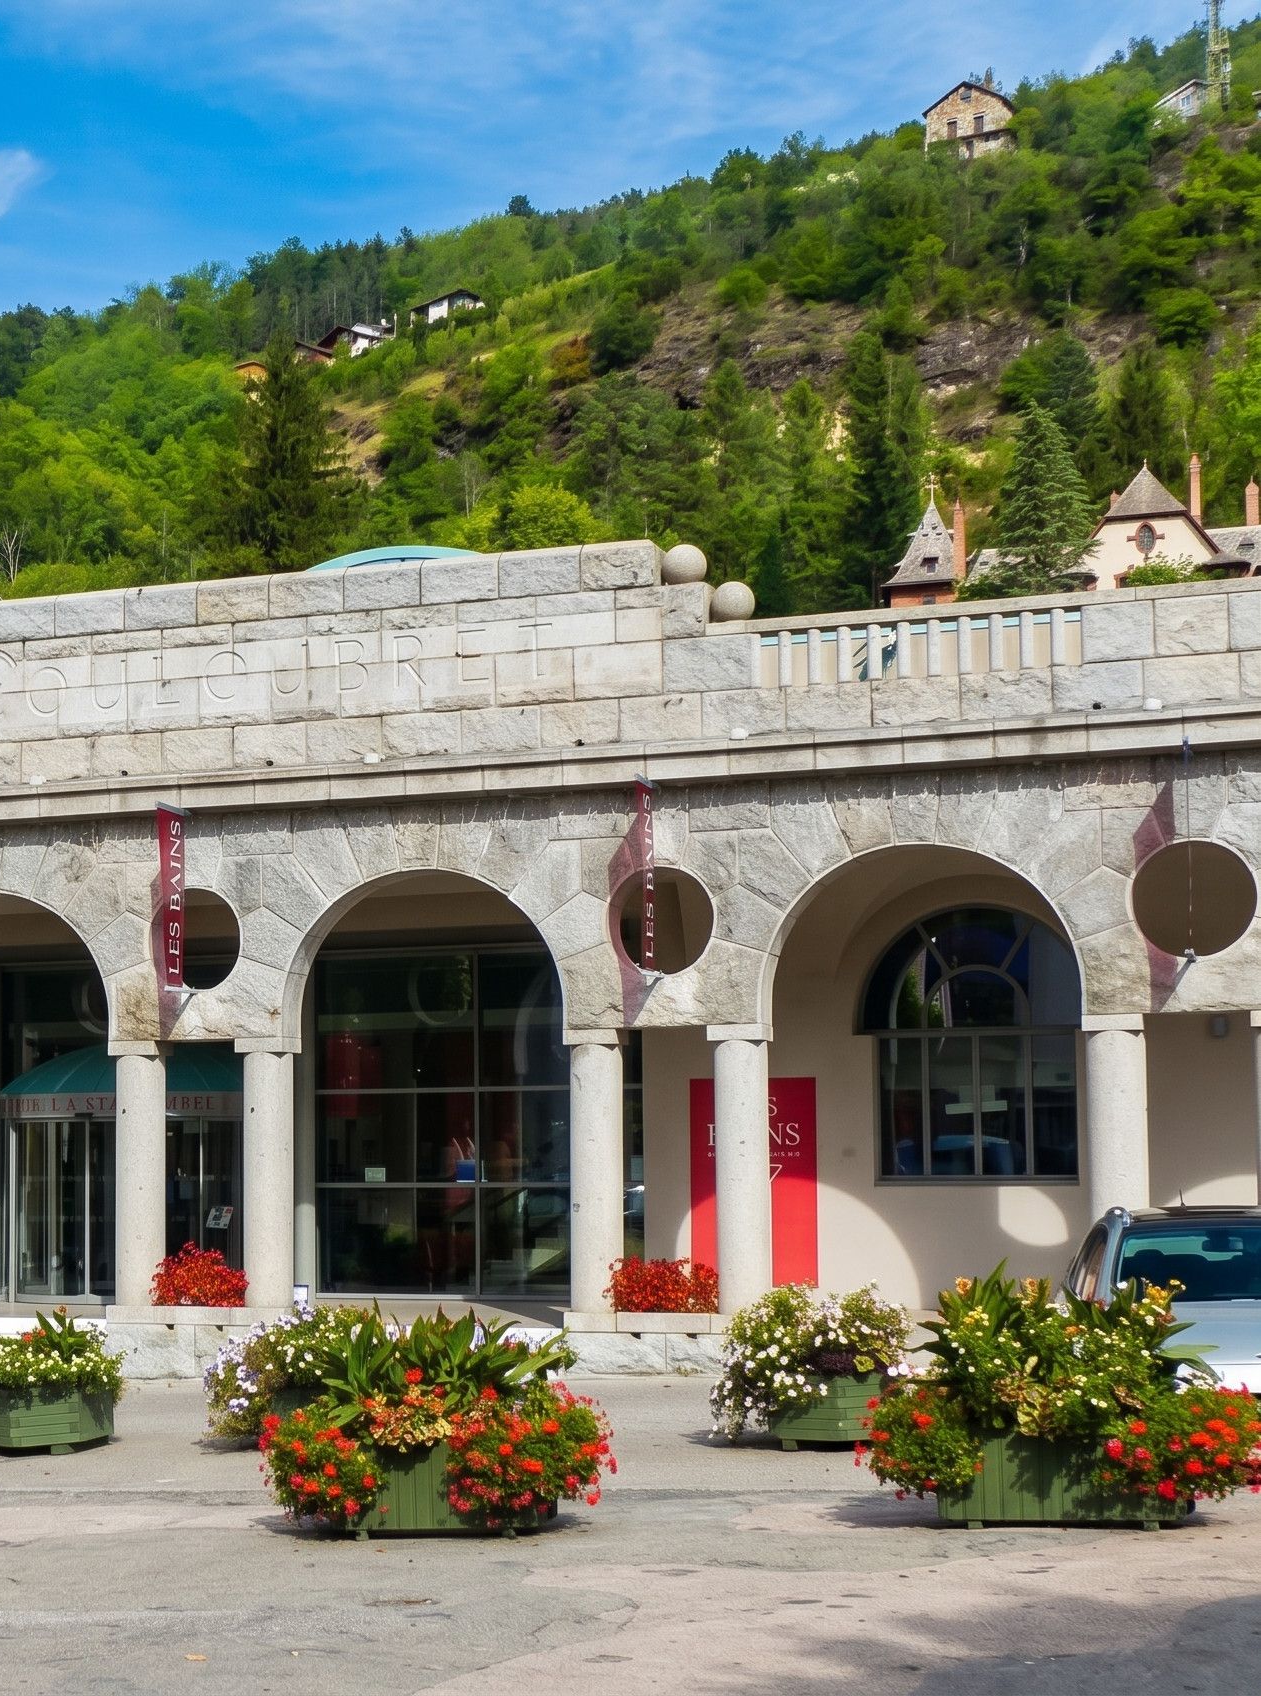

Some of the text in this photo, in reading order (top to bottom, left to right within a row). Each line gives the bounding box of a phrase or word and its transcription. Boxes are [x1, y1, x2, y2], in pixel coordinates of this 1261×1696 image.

[168, 819, 182, 976] LES BAINS
[642, 792, 655, 960] LES BAINS
